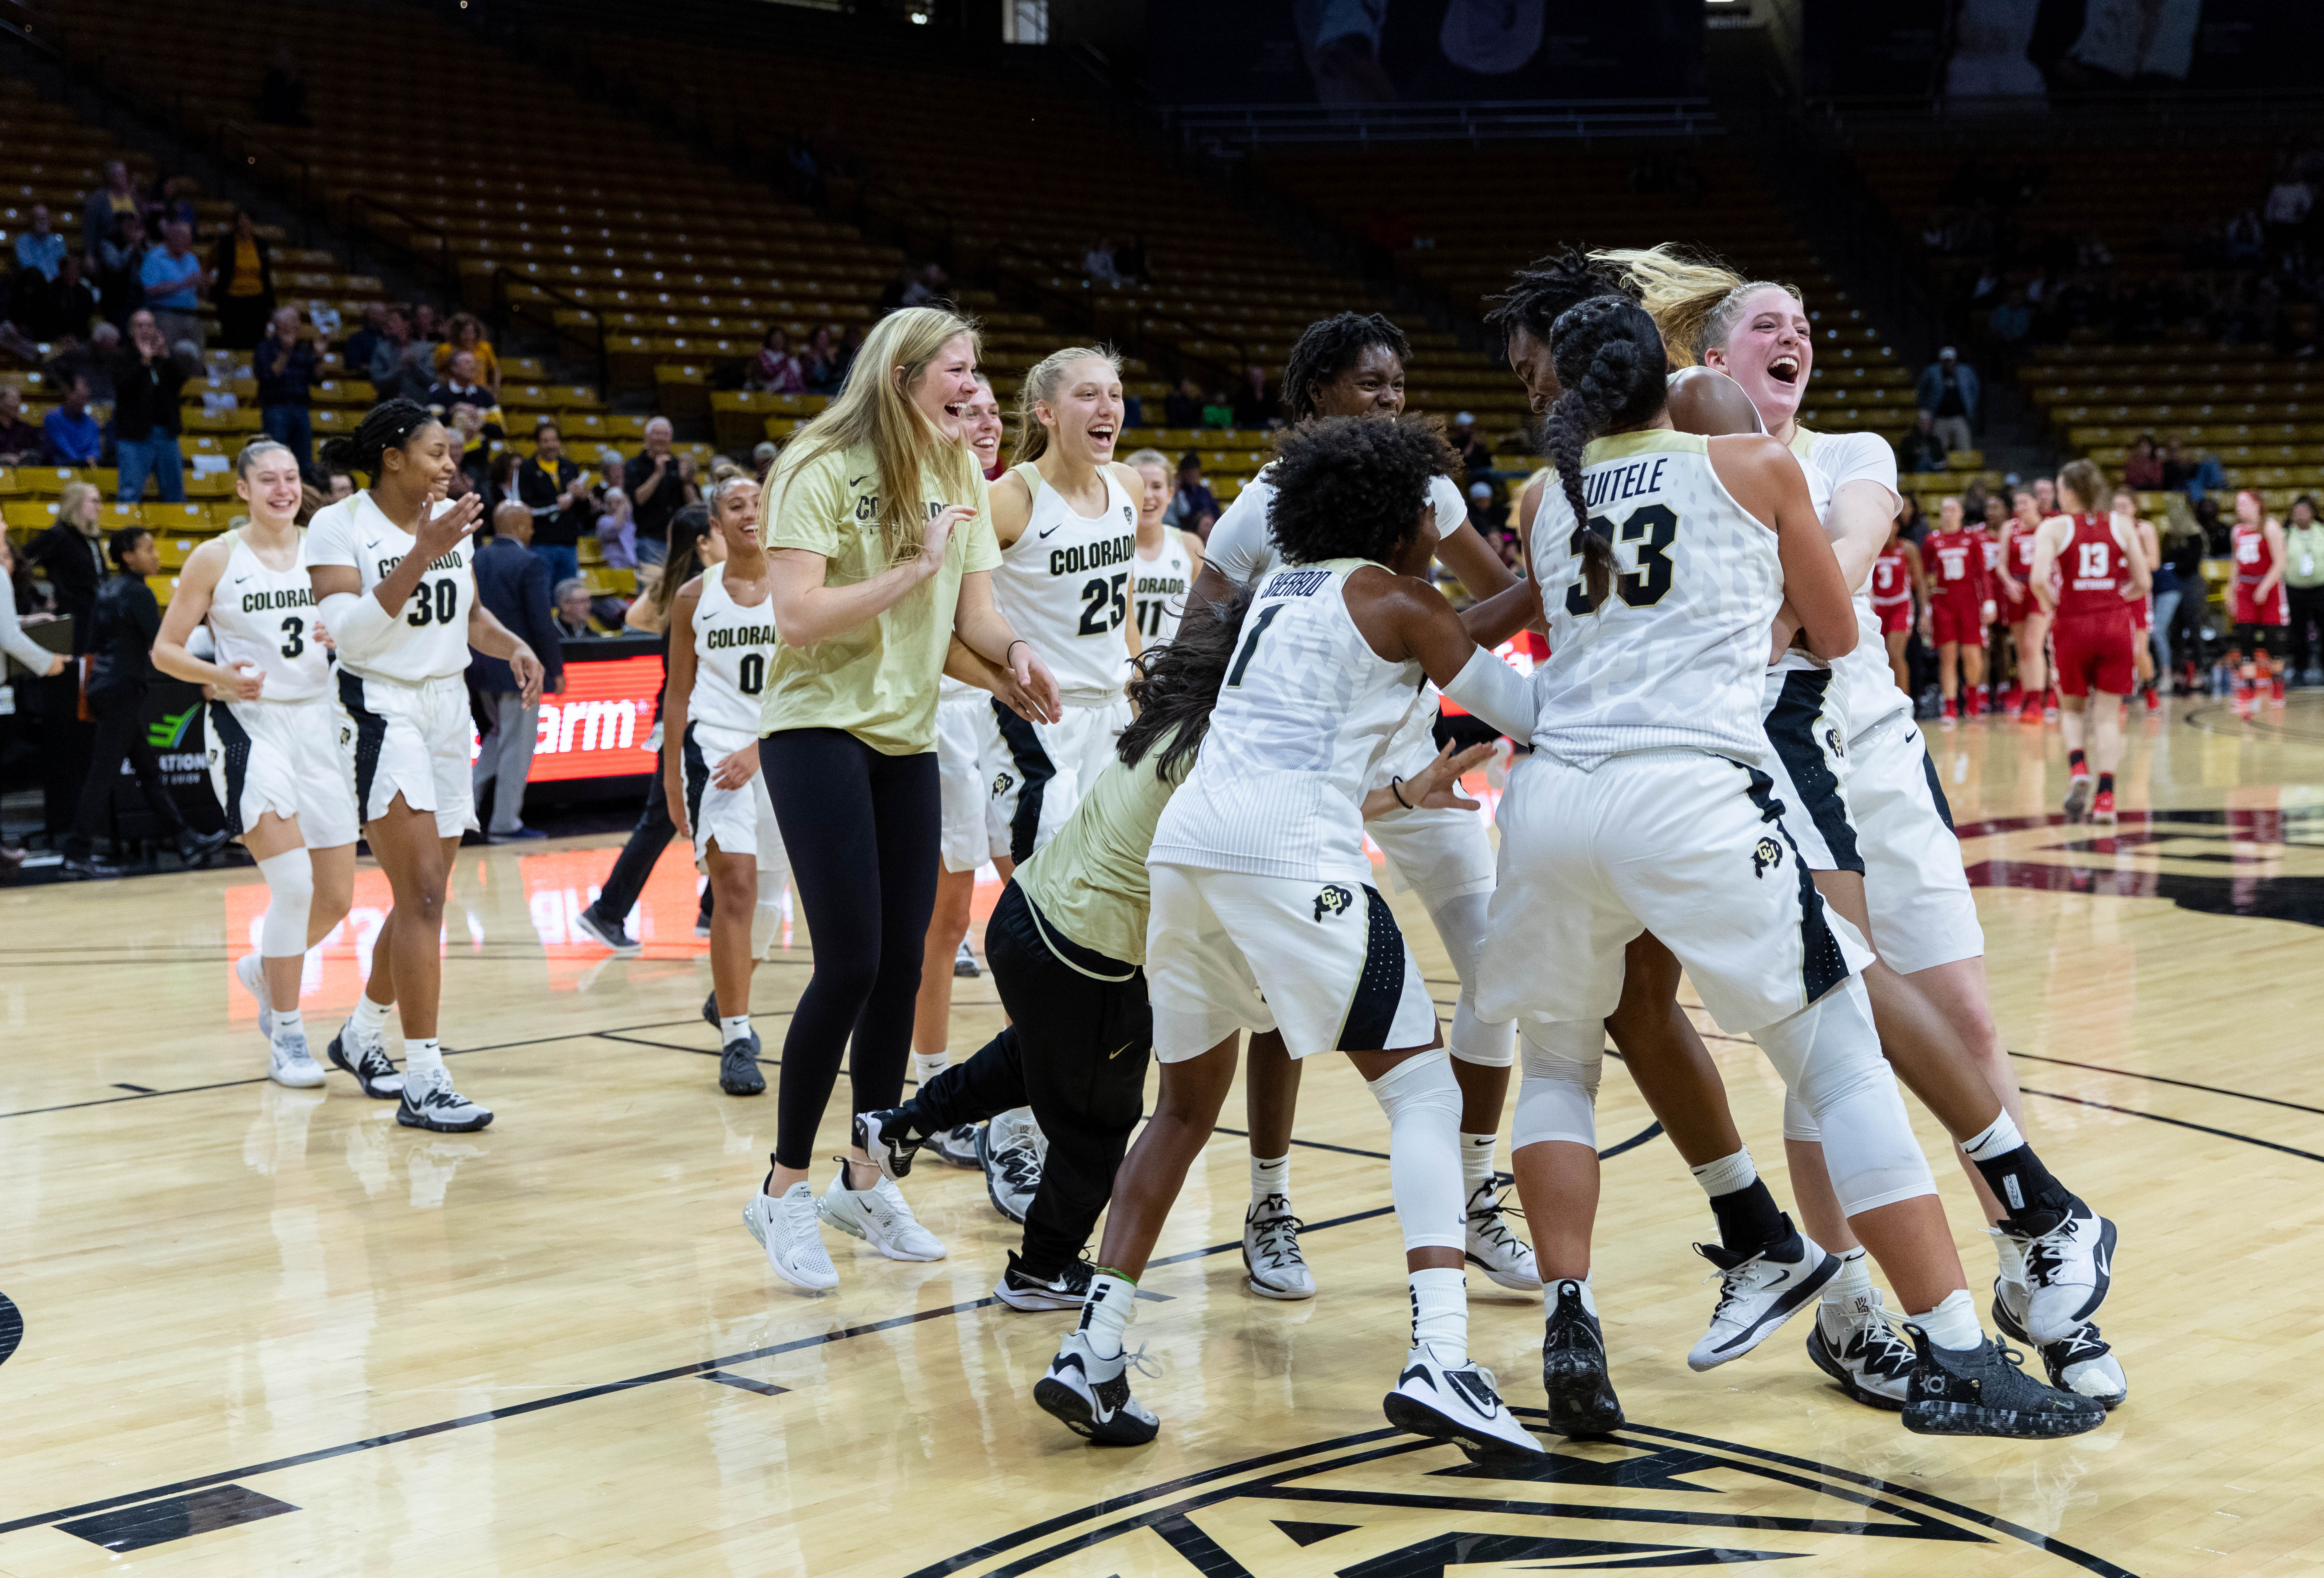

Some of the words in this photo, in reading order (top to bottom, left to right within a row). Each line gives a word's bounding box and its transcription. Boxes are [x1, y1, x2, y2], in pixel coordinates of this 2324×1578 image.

[1583, 458, 1668, 507] UITELE
[1050, 533, 1135, 576] COLORADO
[1565, 503, 1679, 619] 33
[2079, 542, 2108, 577] 13
[407, 579, 457, 627] 30
[1076, 572, 1128, 636] 25
[1133, 578, 1184, 594] ORADO
[1260, 571, 1332, 600] SHERROD
[281, 617, 304, 659] 3
[1136, 600, 1164, 636] 11
[1226, 603, 1288, 689] 1
[740, 653, 764, 696] 0
[533, 699, 636, 755] arm
